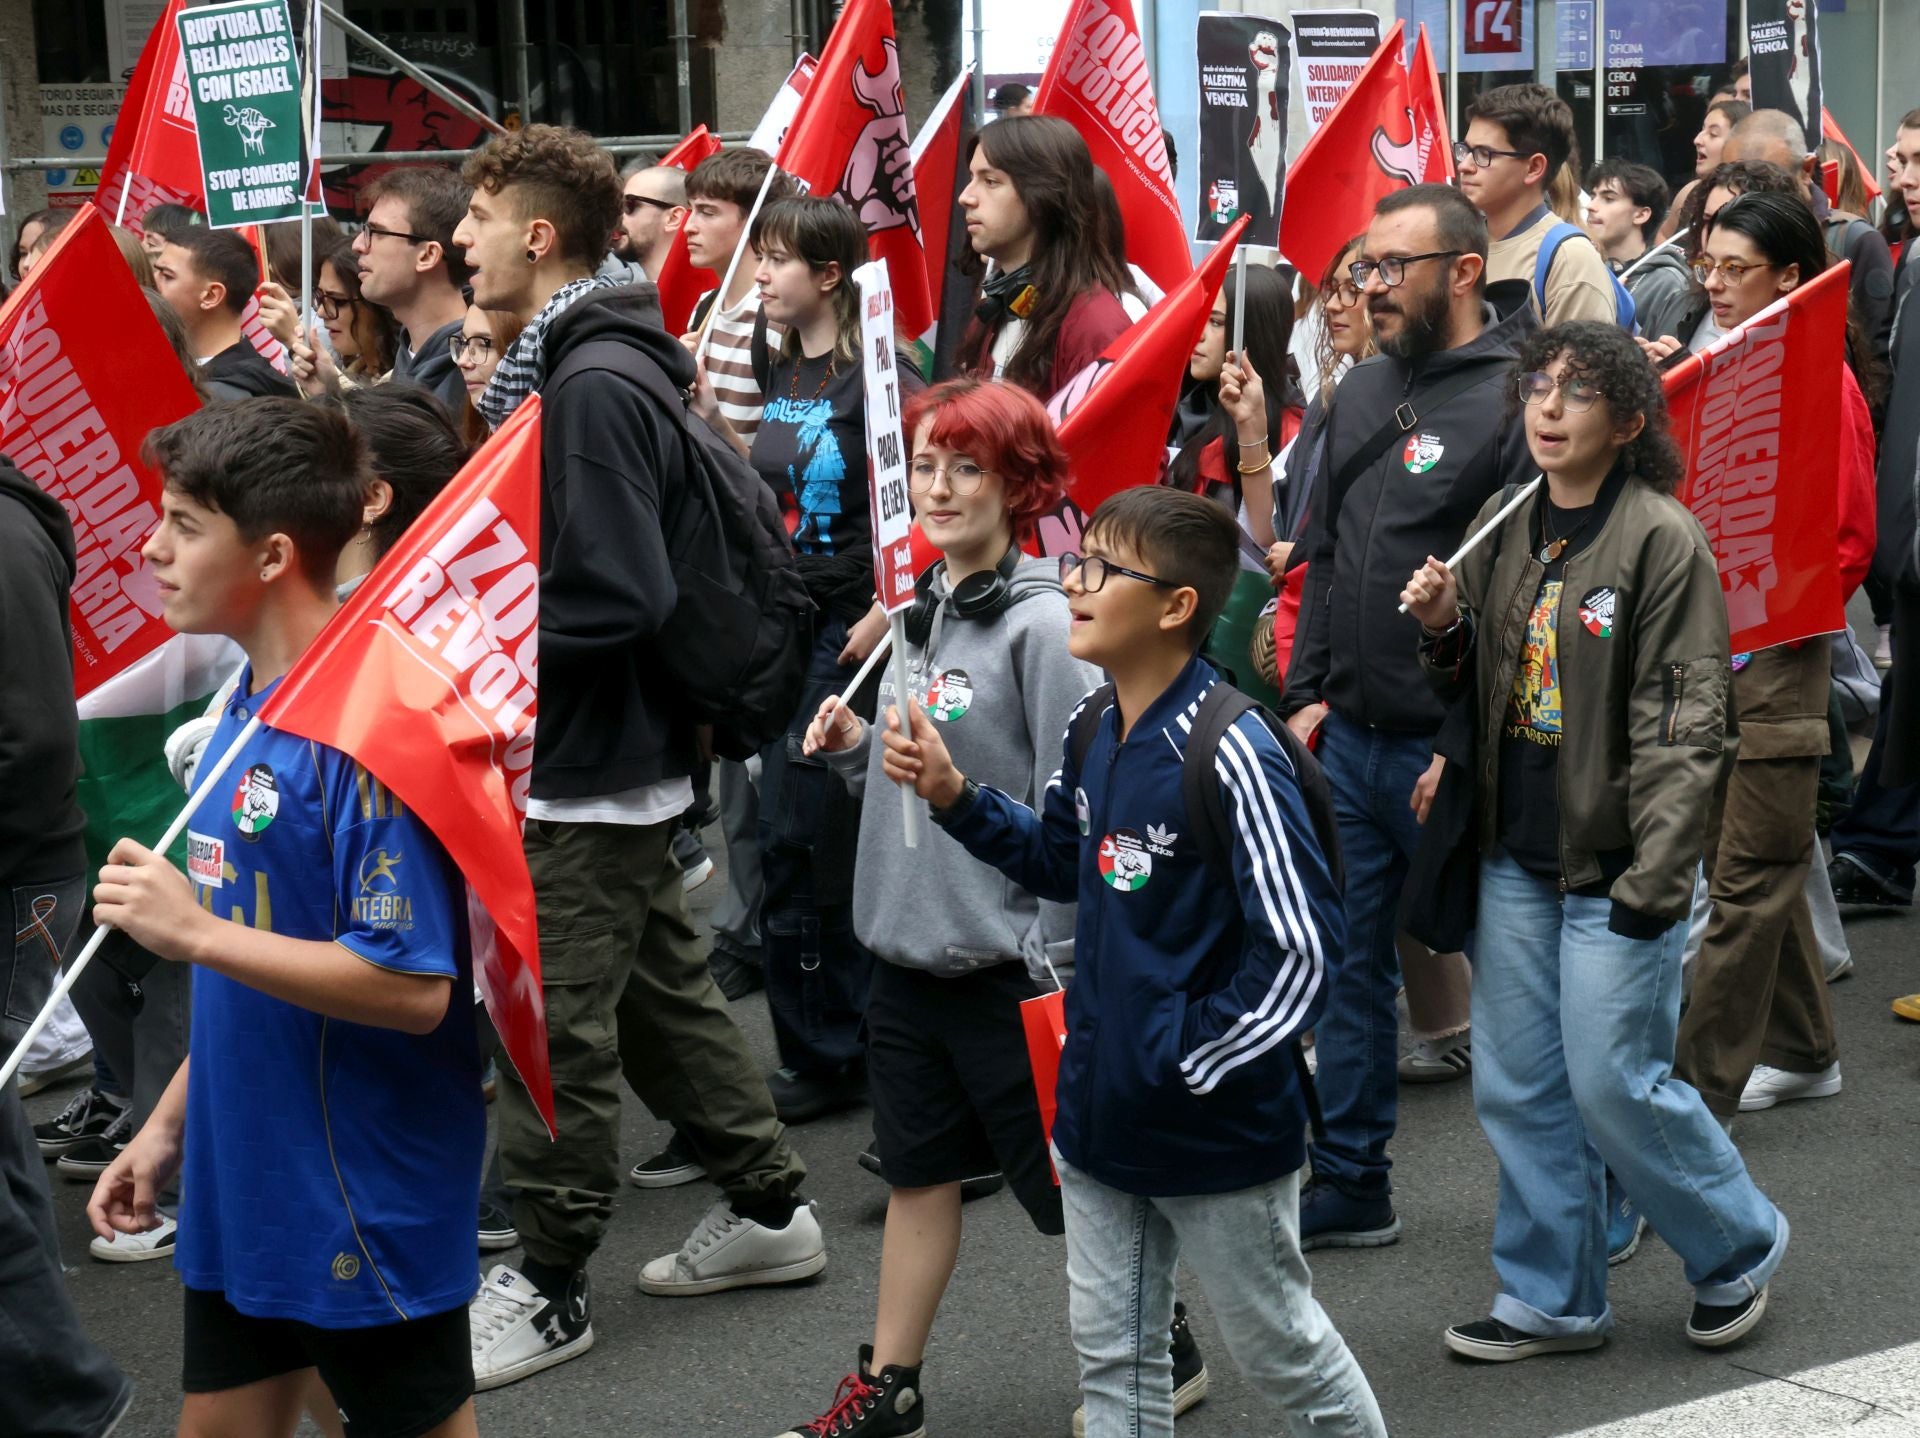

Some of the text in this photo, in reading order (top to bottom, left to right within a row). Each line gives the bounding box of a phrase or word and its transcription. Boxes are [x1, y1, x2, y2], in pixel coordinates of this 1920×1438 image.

[183, 11, 263, 45] RUPTURA
[260, 6, 286, 34] DE
[1609, 29, 1621, 40] TU
[189, 36, 291, 75] RELACIONES
[1609, 43, 1643, 54] OFICINA
[1609, 57, 1643, 68] SIEMPRE
[1203, 74, 1247, 88] PALESTINA
[1608, 71, 1636, 83] CERCA
[197, 75, 233, 103] CON
[234, 66, 293, 99] ISRAEL
[1608, 86, 1630, 97] DE TI
[40, 89, 114, 101] TORIO SEGUIR
[1205, 92, 1248, 108] VENCERA
[1306, 85, 1350, 103] INTERNA
[40, 104, 121, 116] MAS DE SEGUR
[208, 161, 299, 191] STOP COMERCI
[232, 186, 296, 211] DE ARMAS
